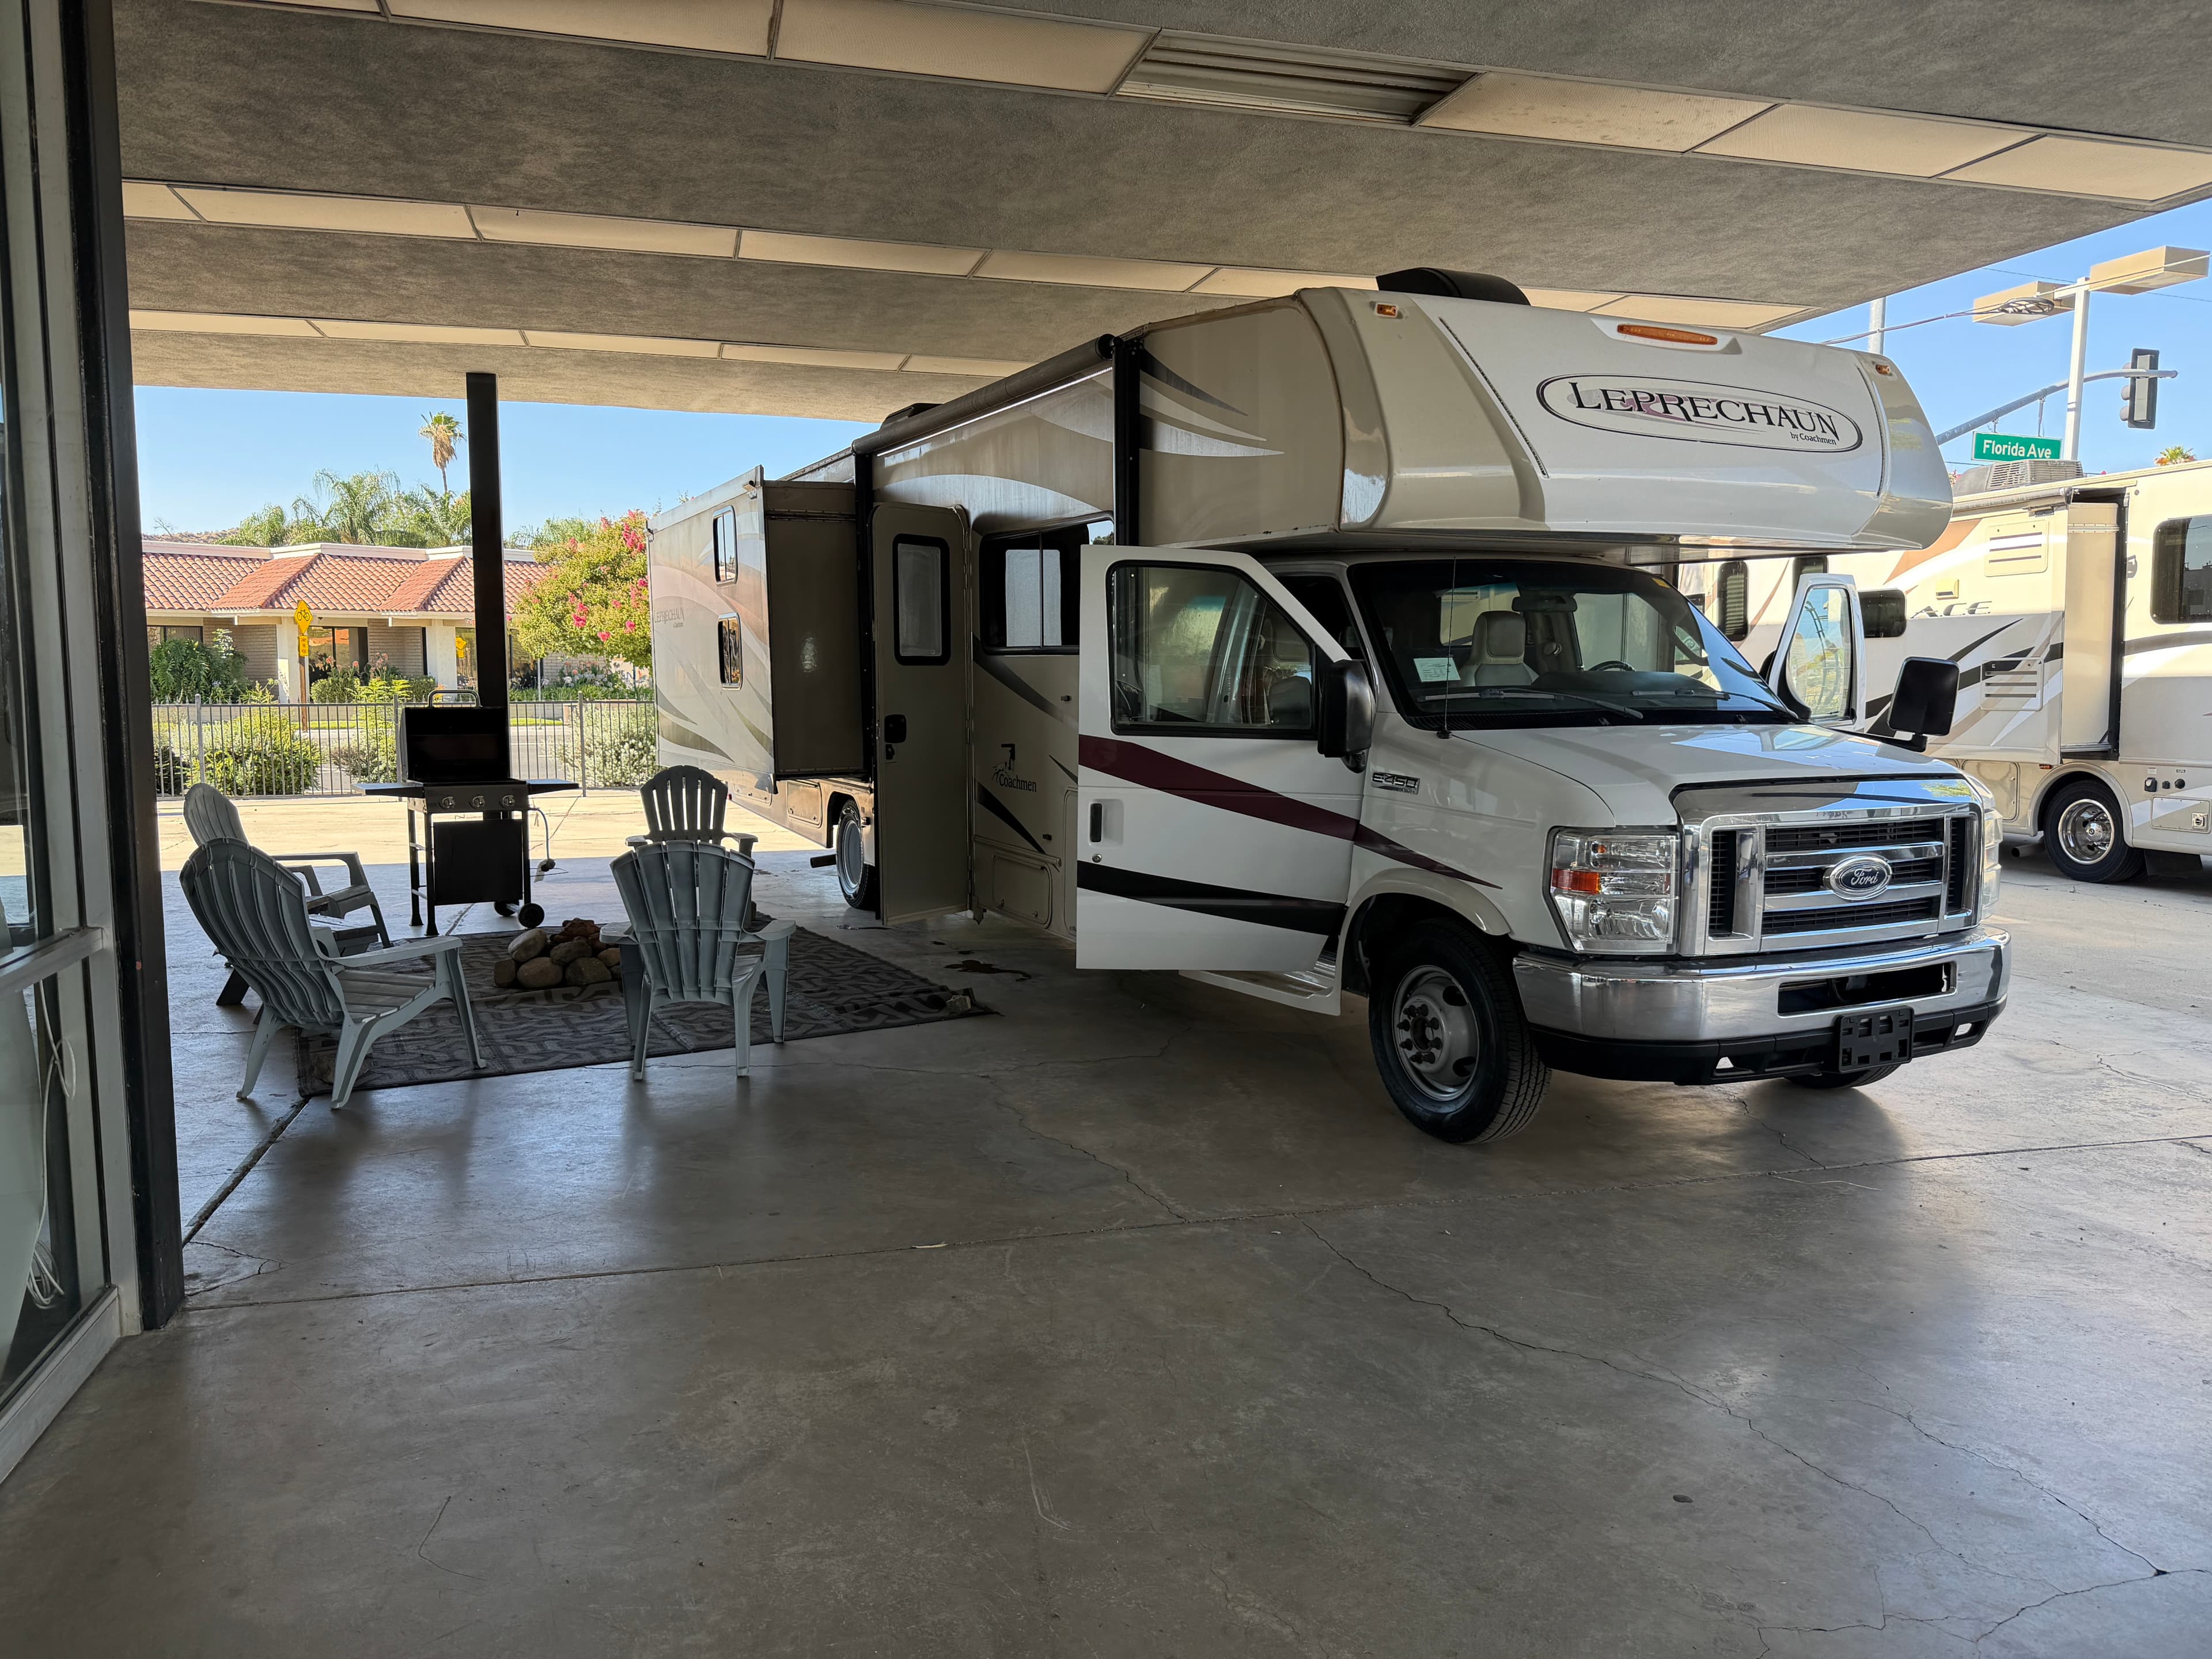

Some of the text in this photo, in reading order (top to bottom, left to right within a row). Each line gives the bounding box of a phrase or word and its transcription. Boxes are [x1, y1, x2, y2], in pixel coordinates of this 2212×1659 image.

[1568, 382, 1839, 441] LEPRECHAUN
[1790, 431, 1836, 445] by Coachmen
[1983, 440, 2051, 459] Florida Ave
[999, 774, 1037, 792] Coachmen
[1851, 868, 1879, 885] Ford
